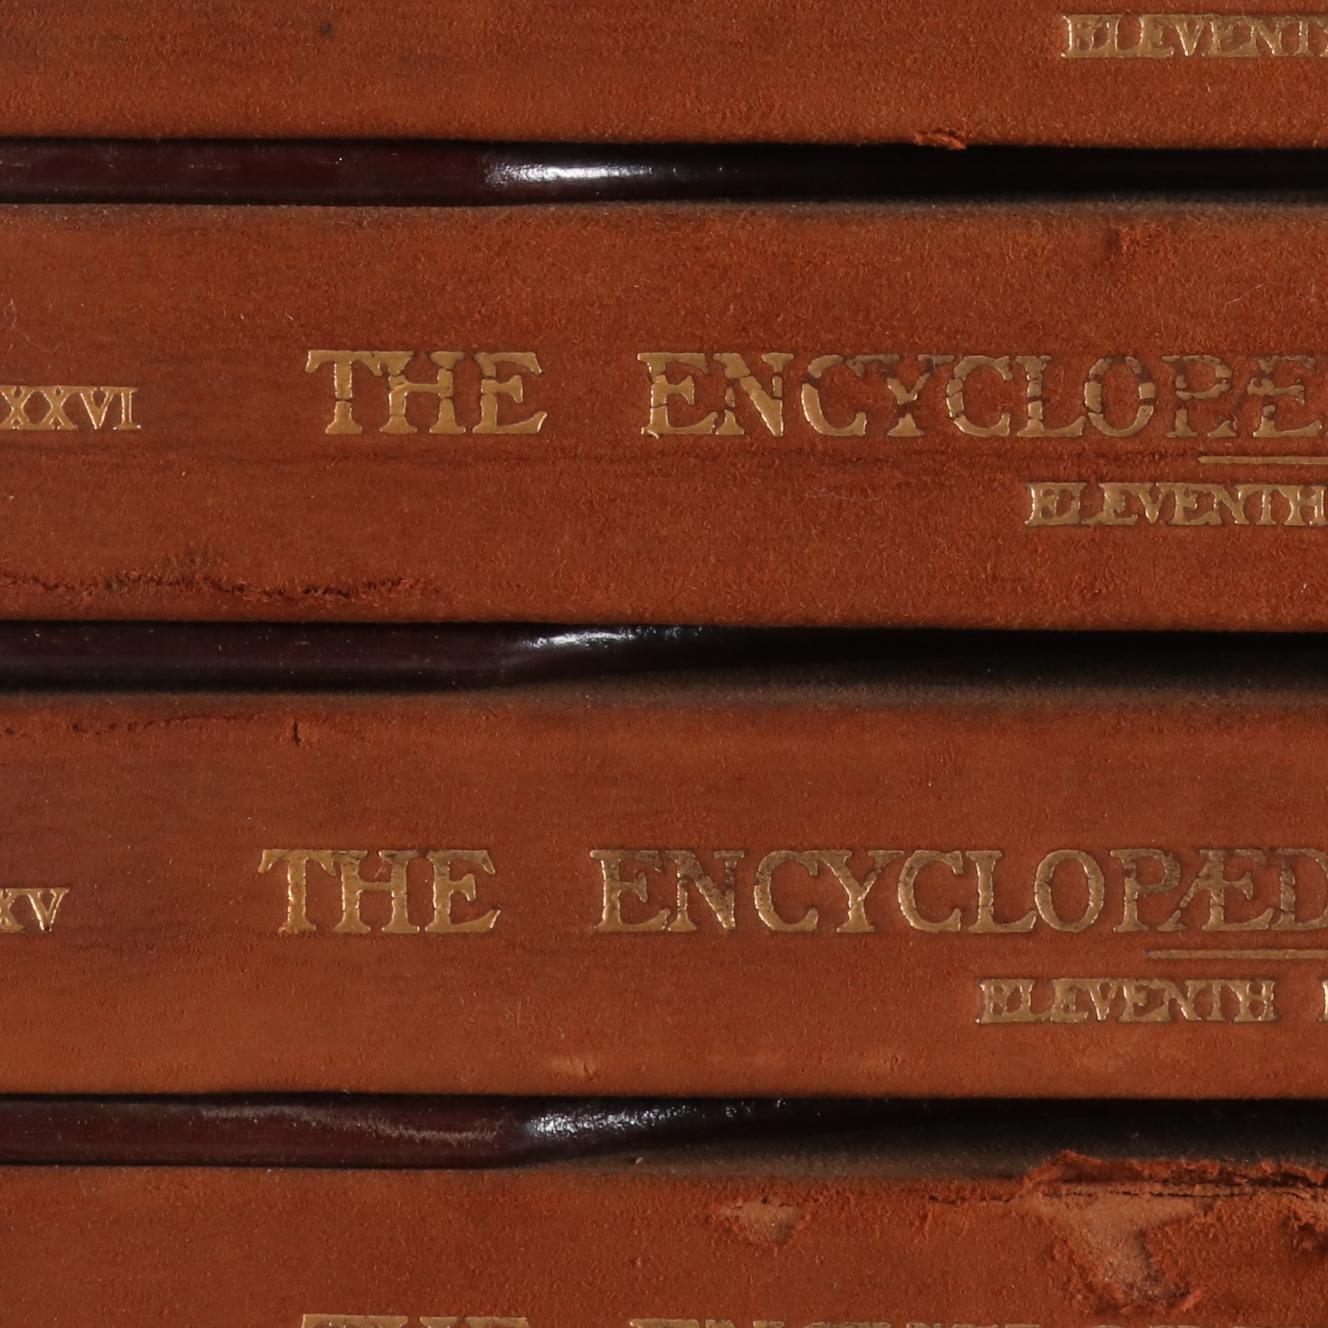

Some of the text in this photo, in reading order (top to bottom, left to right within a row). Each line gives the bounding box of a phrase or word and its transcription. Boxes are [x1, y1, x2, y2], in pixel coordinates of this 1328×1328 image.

[0, 385, 142, 431] XXVI
[304, 349, 548, 435] THE
[1024, 482, 1328, 527] ELEVENTH
[257, 849, 501, 933] THE
[974, 978, 1275, 1024] ELEVENTH
